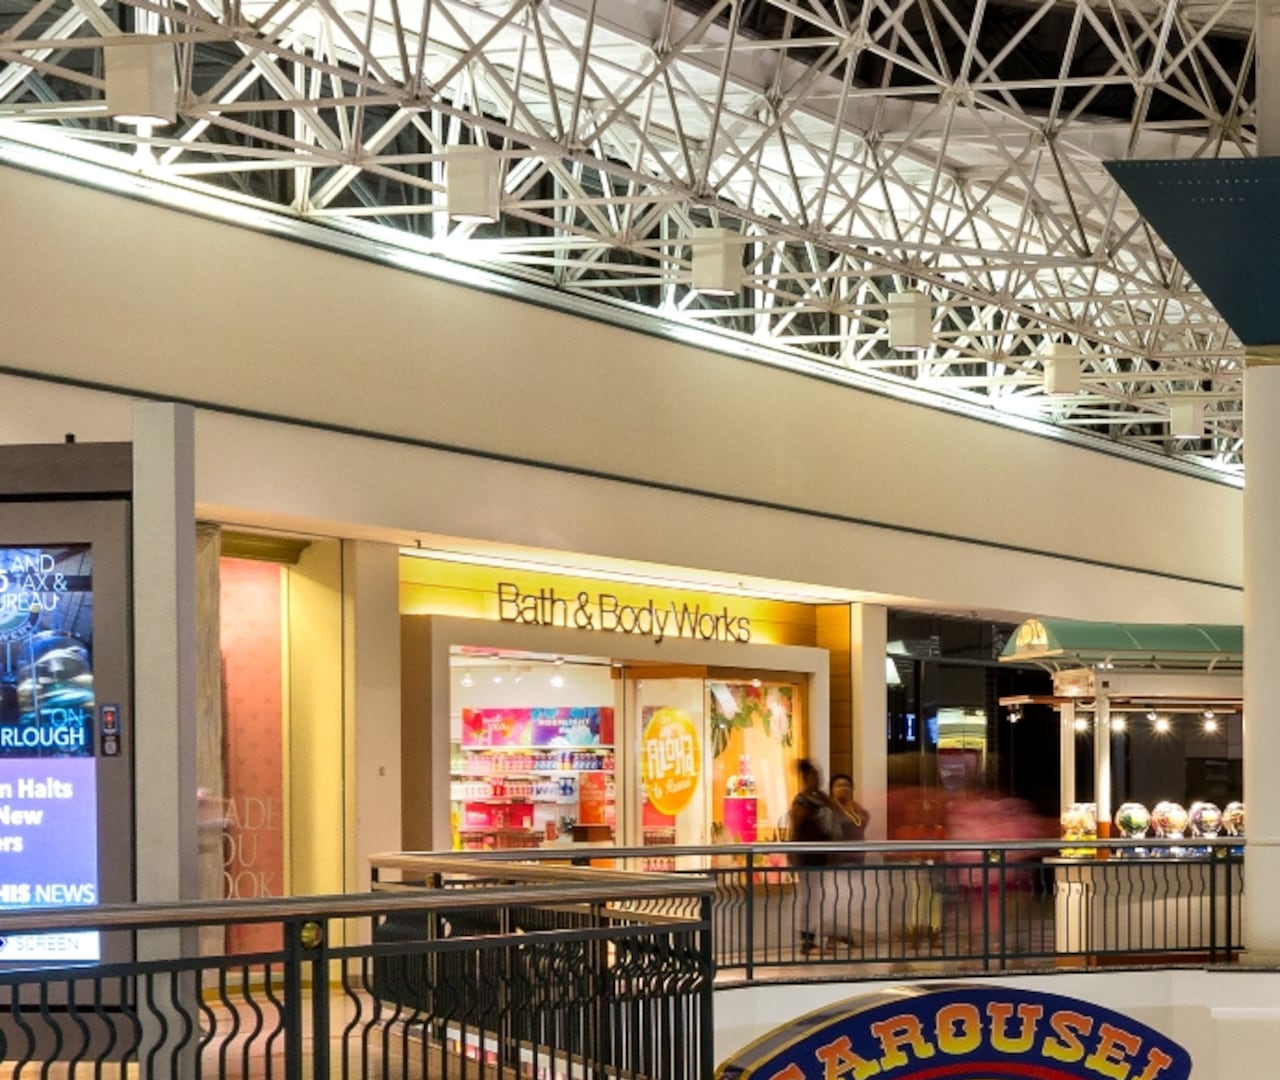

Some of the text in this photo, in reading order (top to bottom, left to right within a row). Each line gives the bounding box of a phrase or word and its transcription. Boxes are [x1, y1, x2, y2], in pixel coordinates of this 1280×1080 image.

[11, 554, 55, 573] AND
[13, 573, 49, 591] TAX
[53, 573, 68, 591] &
[497, 582, 751, 643] Bath & Body Works
[51, 708, 84, 727] ON
[18, 777, 73, 799] Halts
[223, 797, 280, 830] ADE
[35, 884, 96, 904] NEWS
[17, 936, 79, 951] SCREEN
